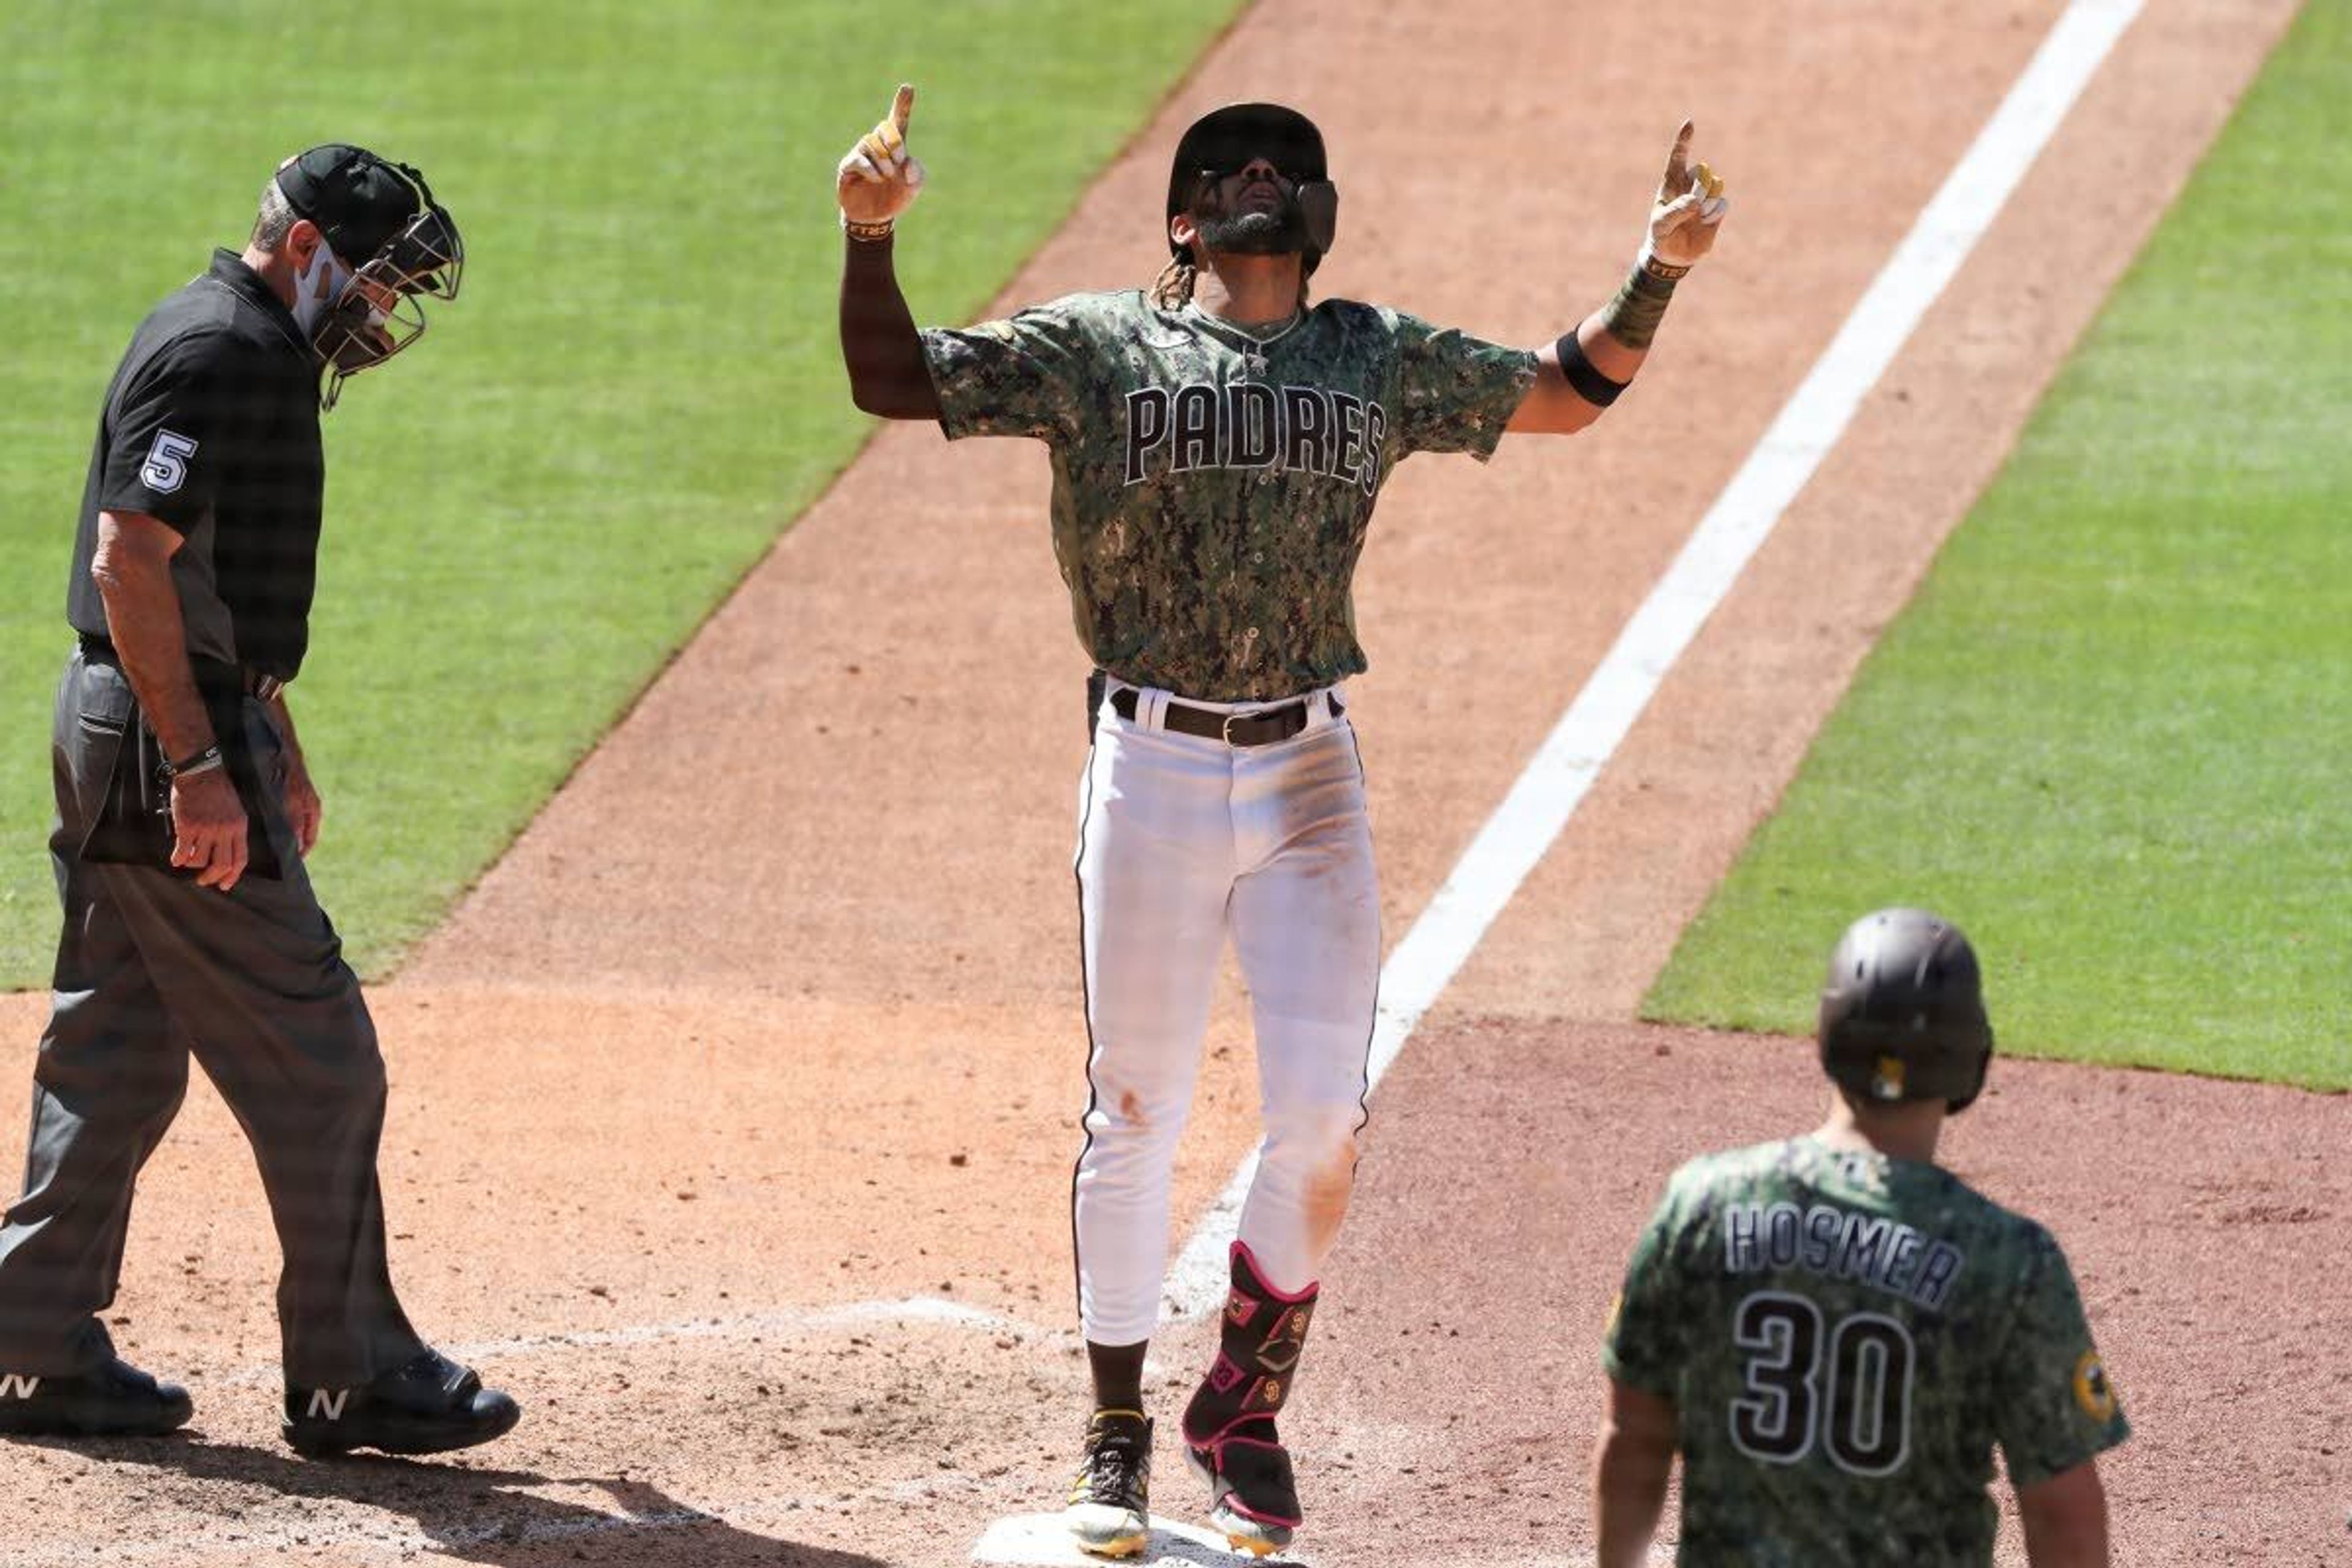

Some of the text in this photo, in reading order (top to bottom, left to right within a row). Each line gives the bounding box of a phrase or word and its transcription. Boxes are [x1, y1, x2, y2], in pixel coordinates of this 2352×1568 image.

[140, 428, 199, 495] 5
[1123, 382, 1387, 497] PADRES
[1724, 1200, 1965, 1312] HOSMER
[1729, 1290, 1915, 1477] 30
